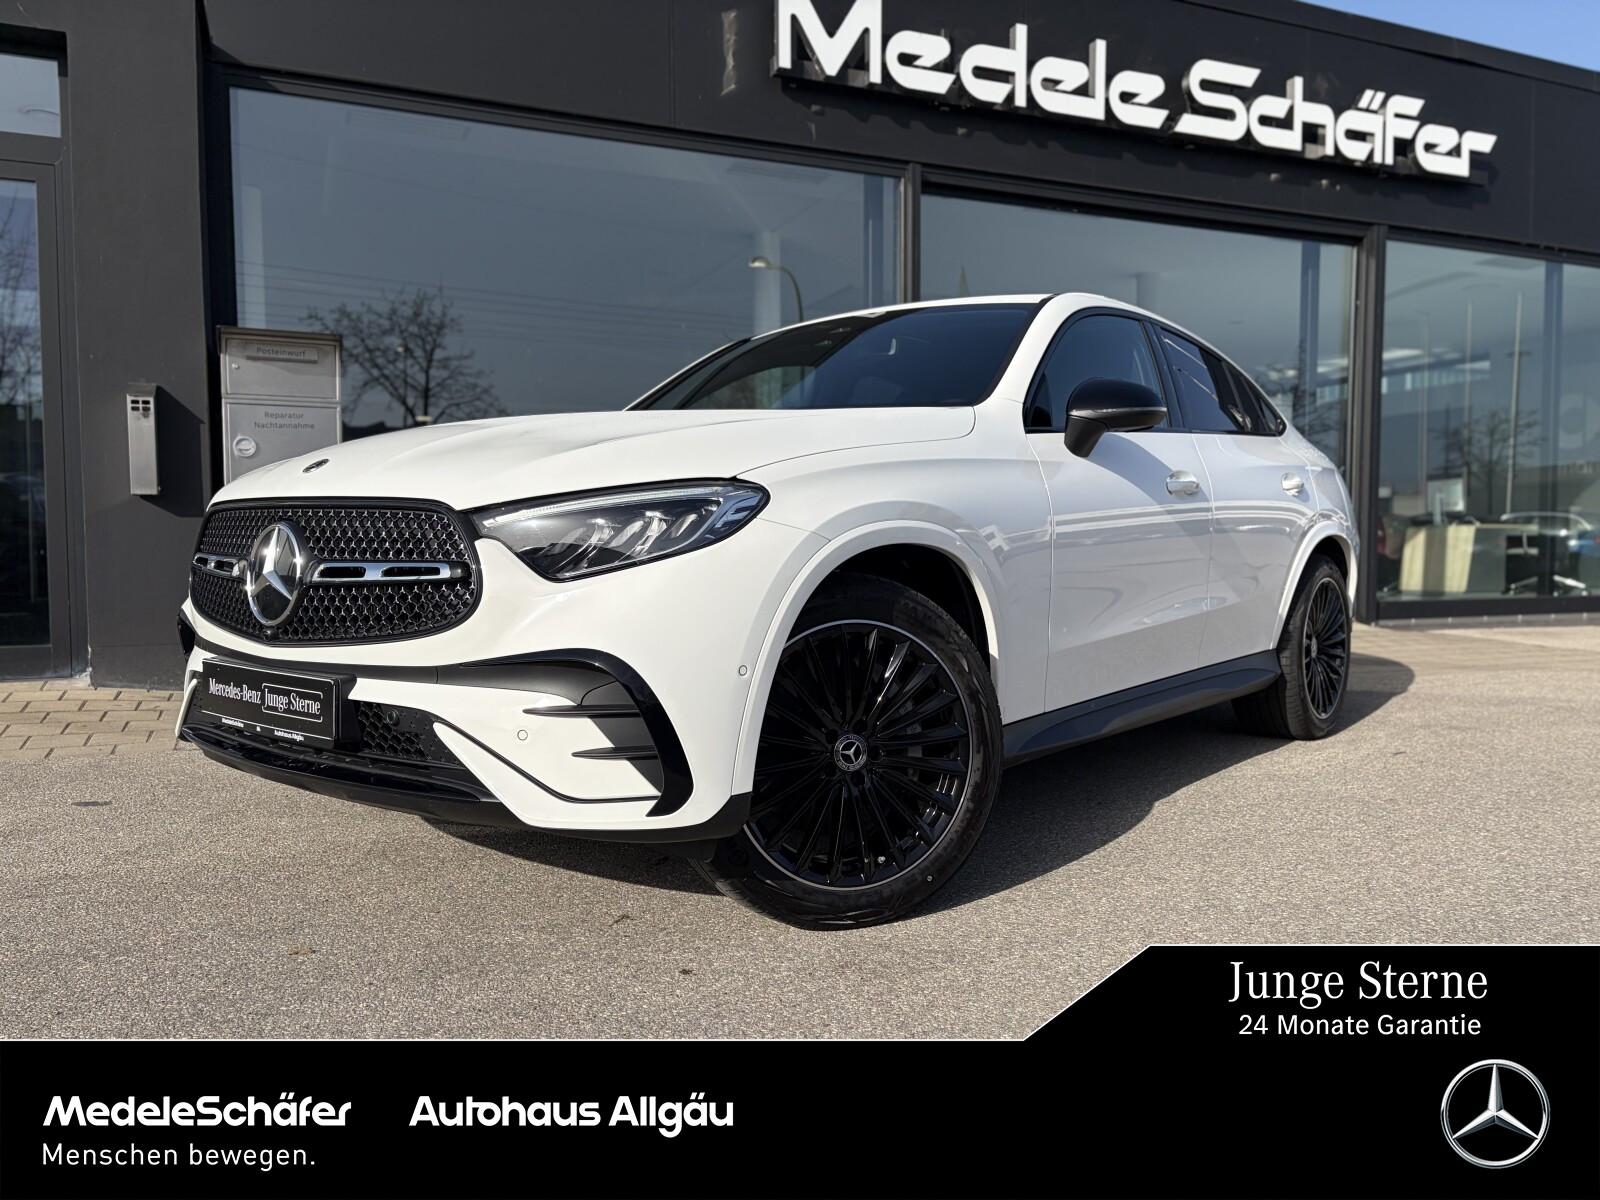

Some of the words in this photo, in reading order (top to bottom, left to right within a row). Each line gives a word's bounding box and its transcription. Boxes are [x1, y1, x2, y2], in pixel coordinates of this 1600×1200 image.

[256, 346, 306, 358] Posteinwurf
[264, 411, 304, 420] Reparatur
[254, 421, 315, 430] Nachtannahme
[208, 677, 262, 704] Mercedes-Benz
[264, 688, 289, 712] Junge
[290, 692, 321, 715] Sterne
